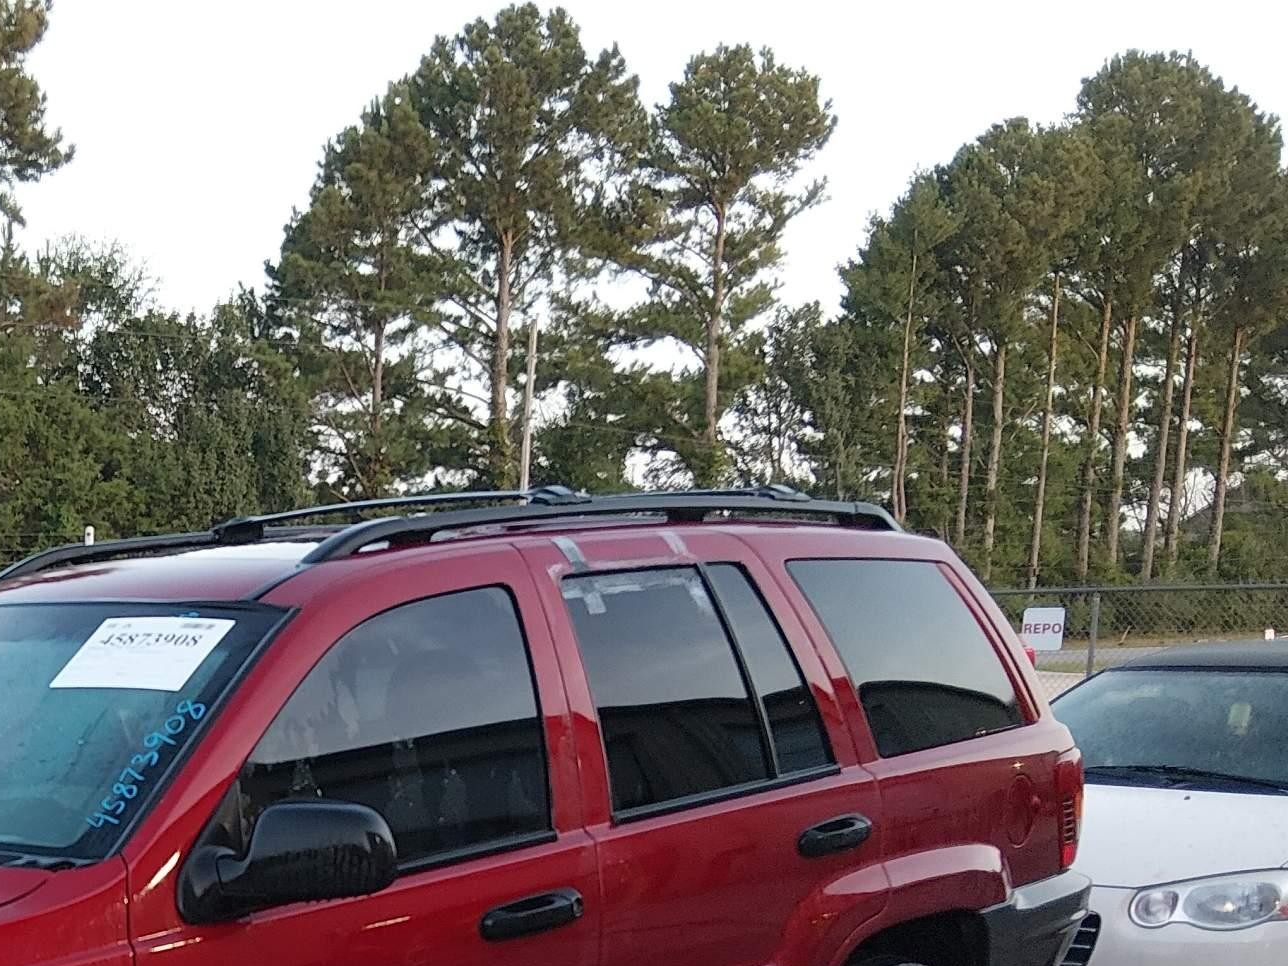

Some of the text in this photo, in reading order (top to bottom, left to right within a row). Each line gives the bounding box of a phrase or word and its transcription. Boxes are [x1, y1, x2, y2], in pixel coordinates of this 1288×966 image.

[1023, 622, 1063, 635] REPO
[99, 632, 204, 648] 45873908
[85, 699, 207, 829] 45873908
